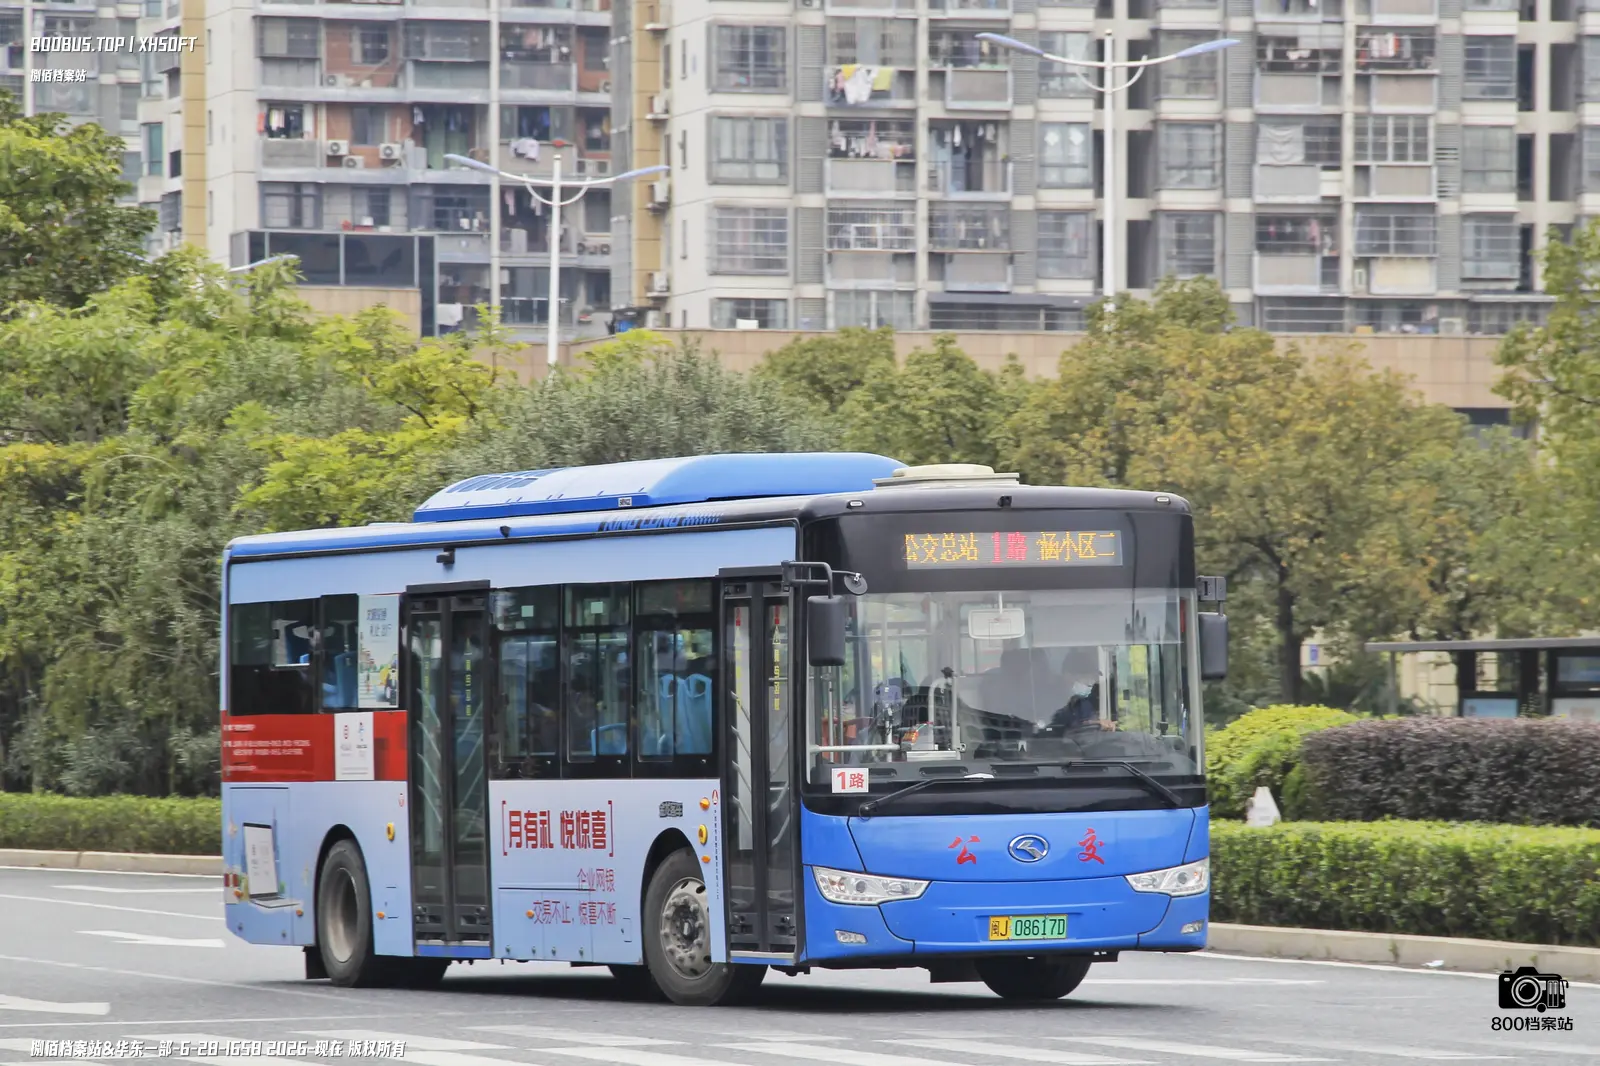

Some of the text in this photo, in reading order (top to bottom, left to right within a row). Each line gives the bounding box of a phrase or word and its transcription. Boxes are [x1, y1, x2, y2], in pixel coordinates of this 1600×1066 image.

[991, 531, 1027, 563] 1路
[837, 771, 865, 790] 1路
[508, 809, 607, 850] 月有礼 悦惊喜
